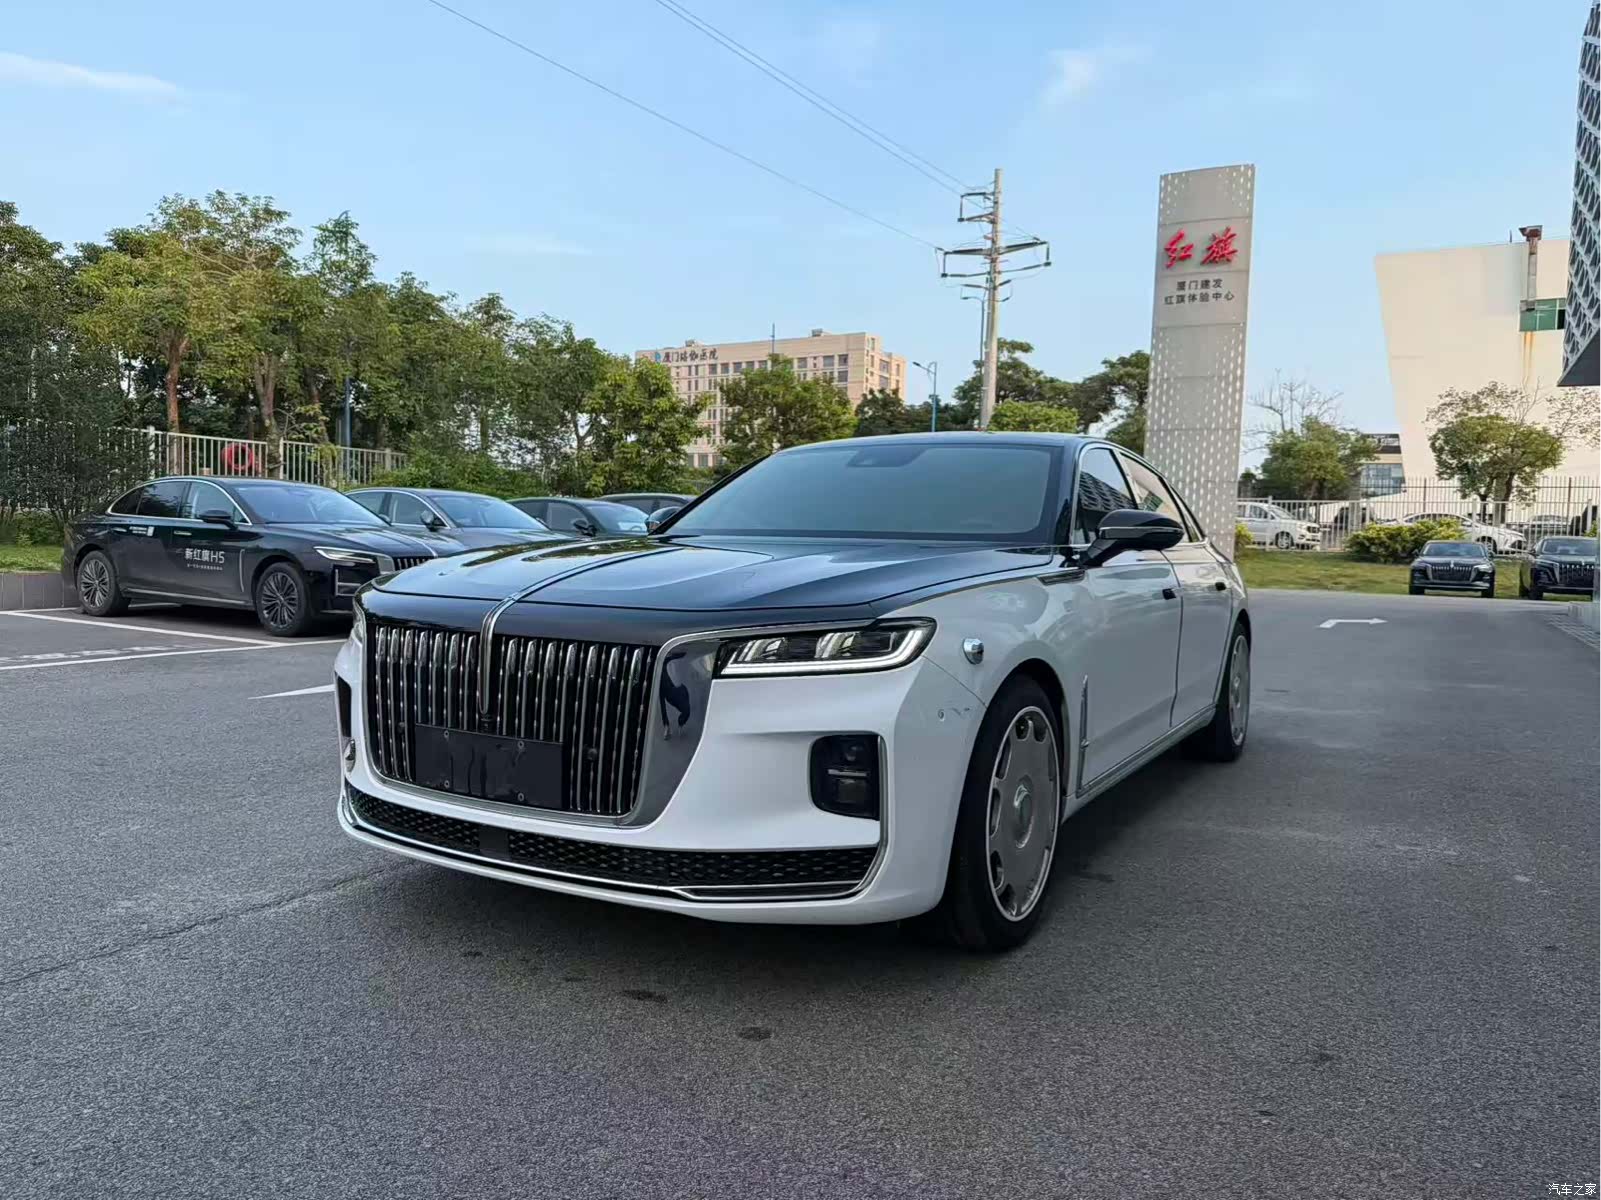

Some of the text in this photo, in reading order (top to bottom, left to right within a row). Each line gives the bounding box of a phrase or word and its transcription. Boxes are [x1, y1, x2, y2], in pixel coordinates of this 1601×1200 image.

[1164, 227, 1238, 269] 红旗
[1164, 291, 1235, 305] 红旗体验中心
[185, 548, 225, 564] 新红旗H5
